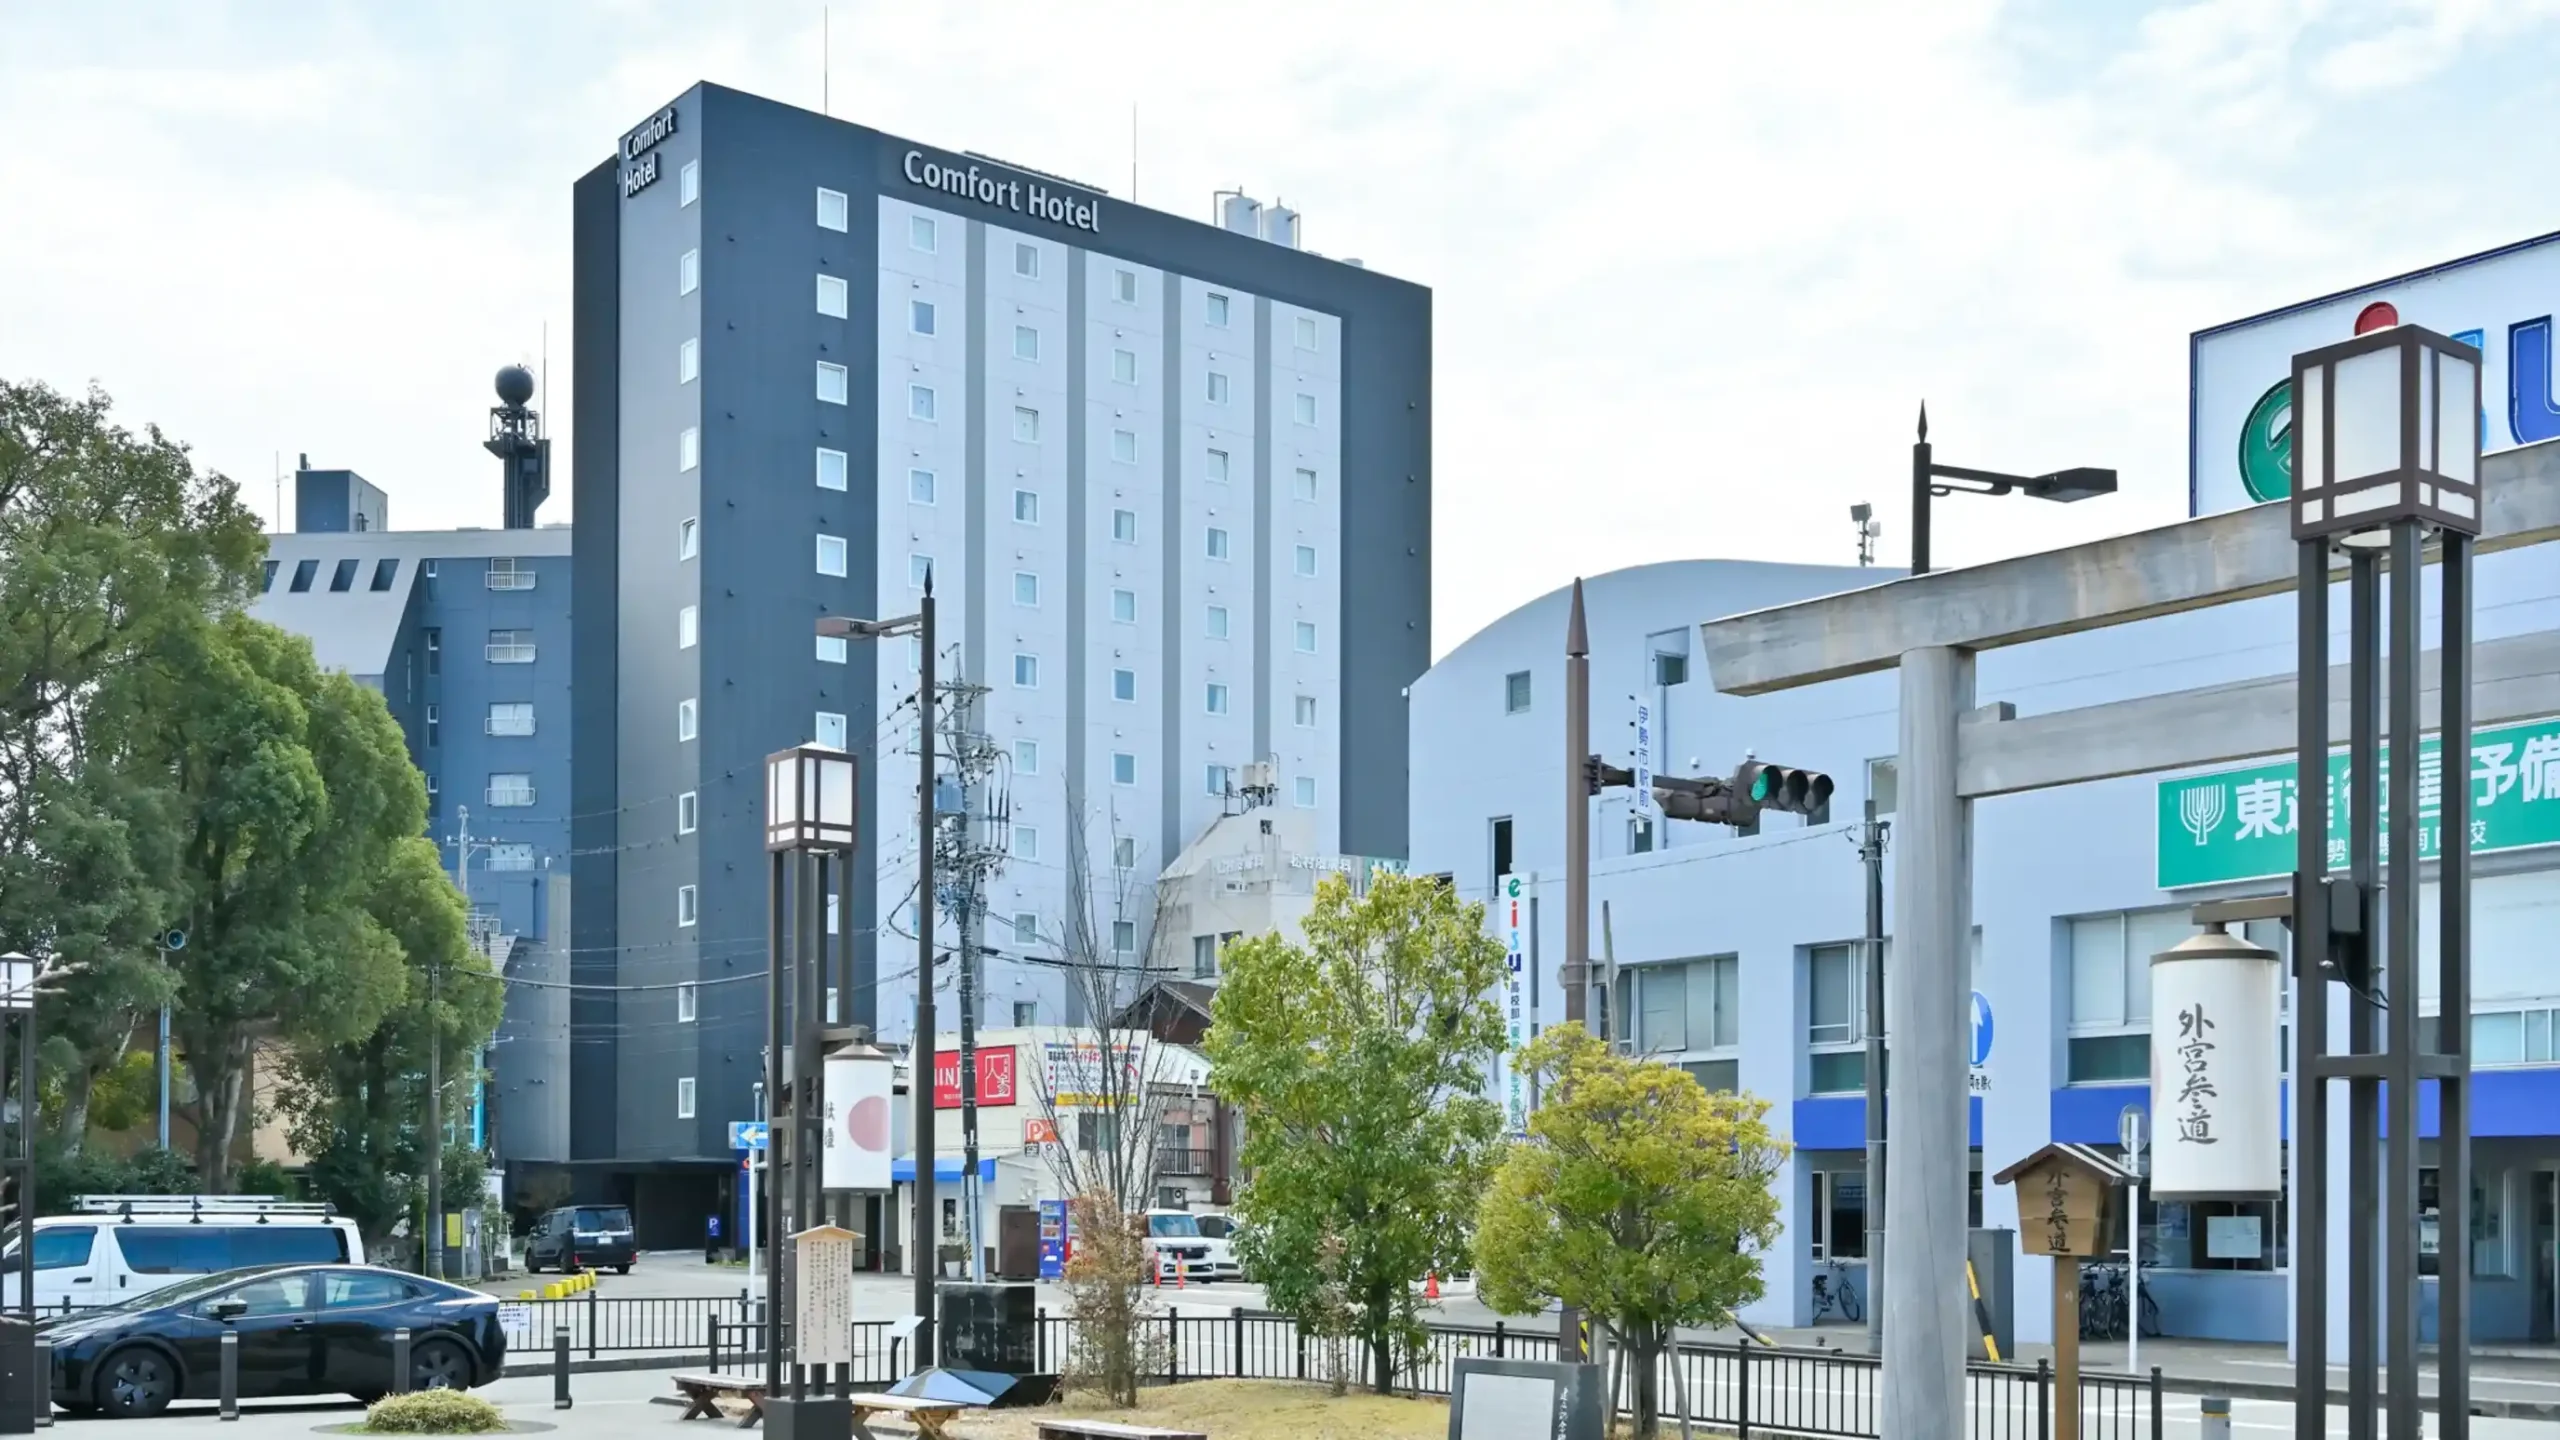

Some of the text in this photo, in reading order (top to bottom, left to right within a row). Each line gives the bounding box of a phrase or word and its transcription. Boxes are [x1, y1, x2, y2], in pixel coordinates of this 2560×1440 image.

[625, 108, 673, 160] Comfort
[625, 153, 656, 197] Hotel
[904, 150, 1100, 233] Comfort Hotel
[2177, 1003, 2218, 1145] 外宮参道
[709, 1217, 719, 1229] P
